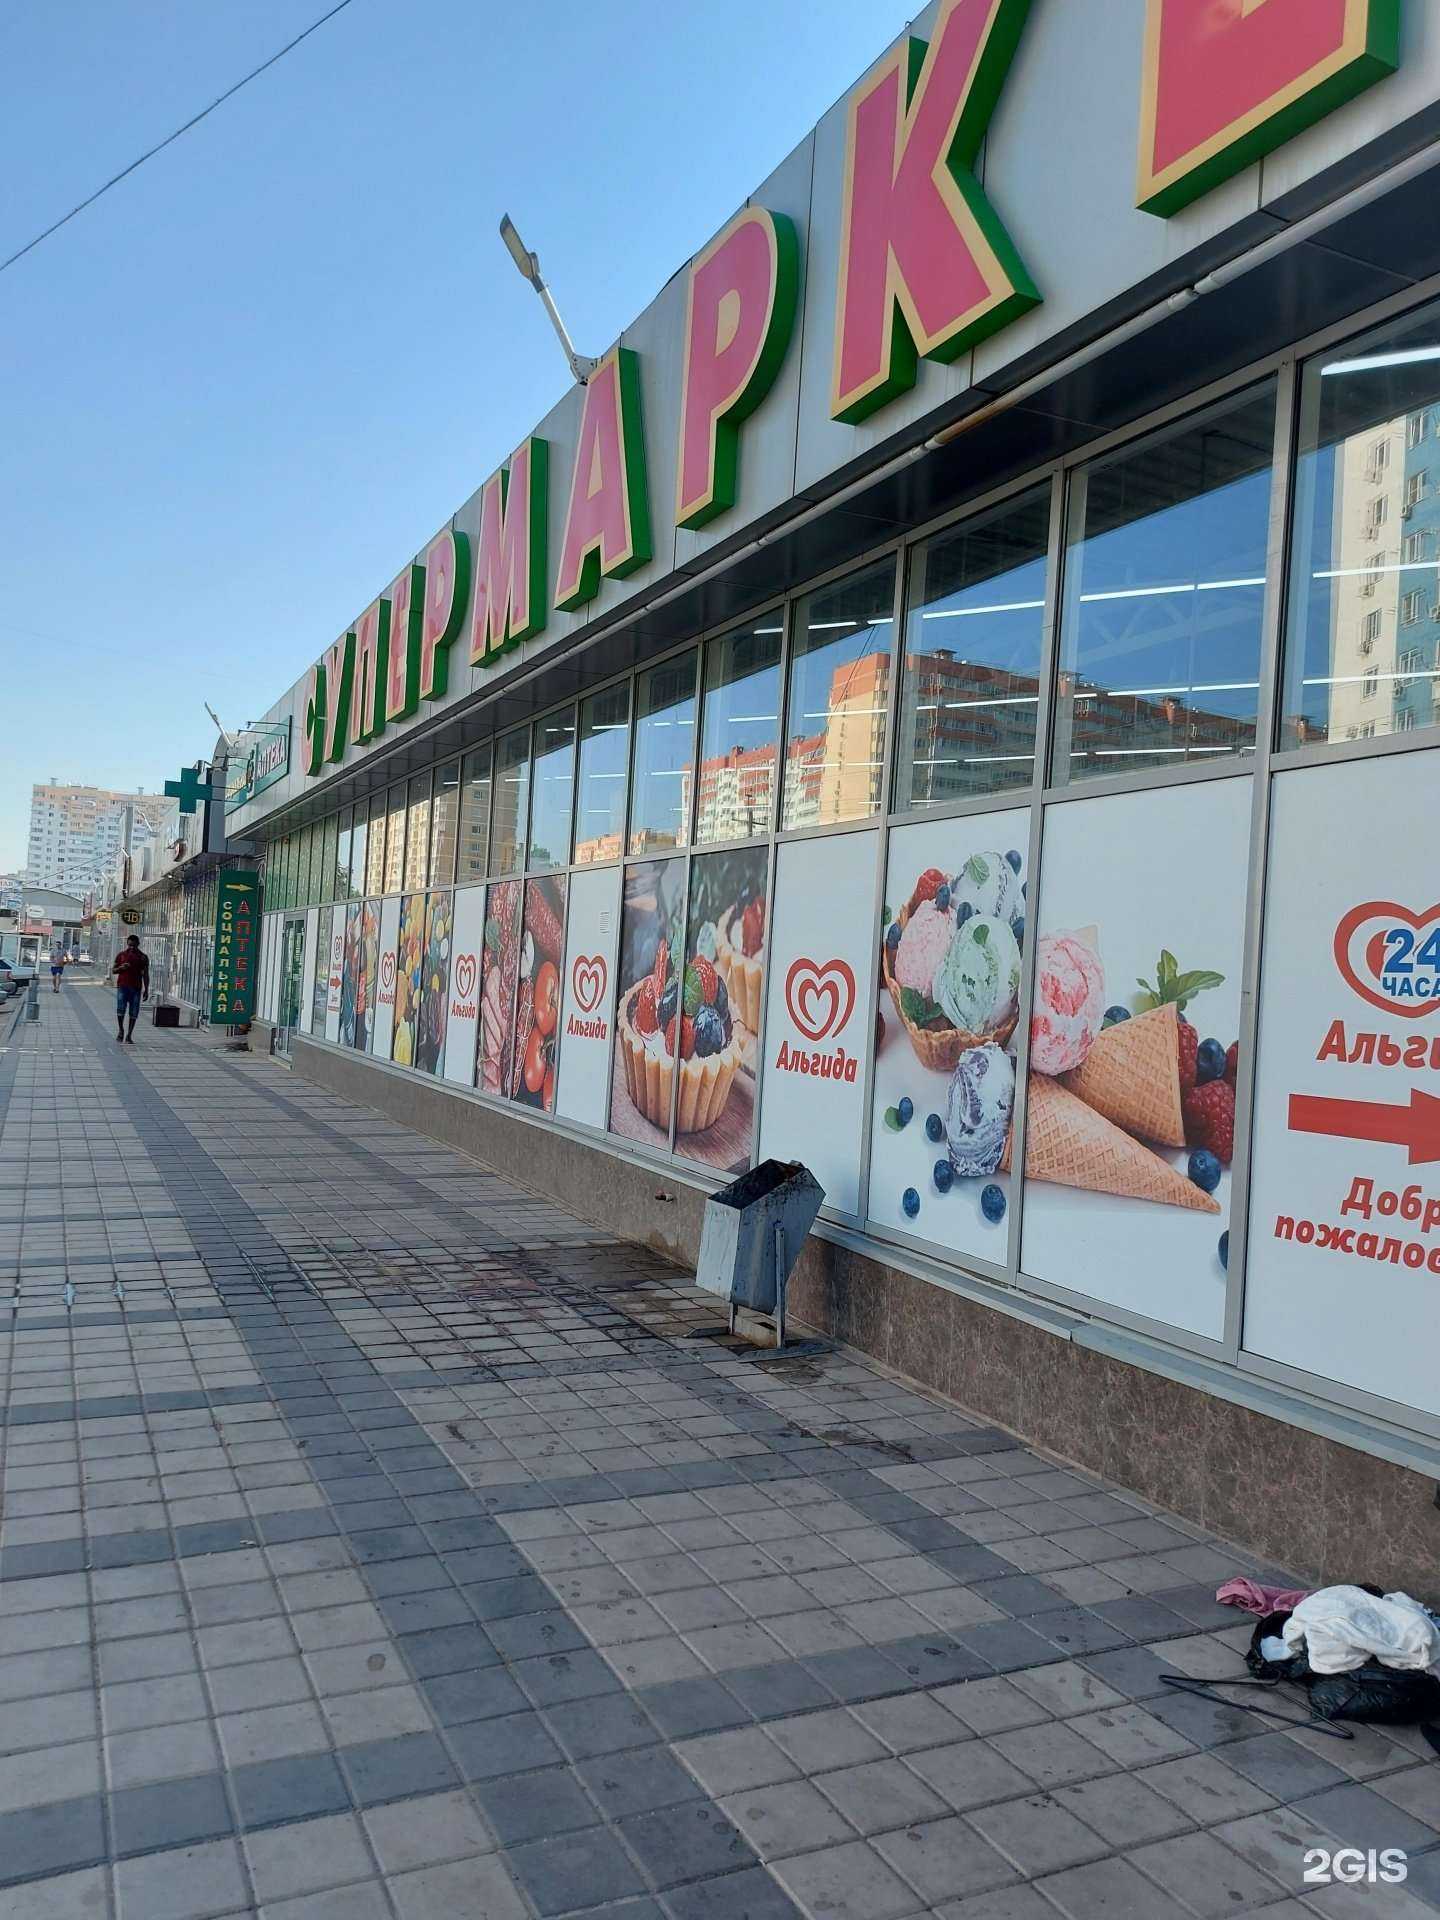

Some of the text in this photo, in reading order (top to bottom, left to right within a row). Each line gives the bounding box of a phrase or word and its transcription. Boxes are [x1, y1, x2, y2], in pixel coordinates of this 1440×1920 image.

[216, 901, 233, 1013] СОЦИАЛЬНАЯ
[232, 900, 251, 1012] АПТЕКА
[1383, 928, 1440, 974] 24
[566, 1013, 608, 1040] Альгида
[775, 1040, 858, 1083] Альгида
